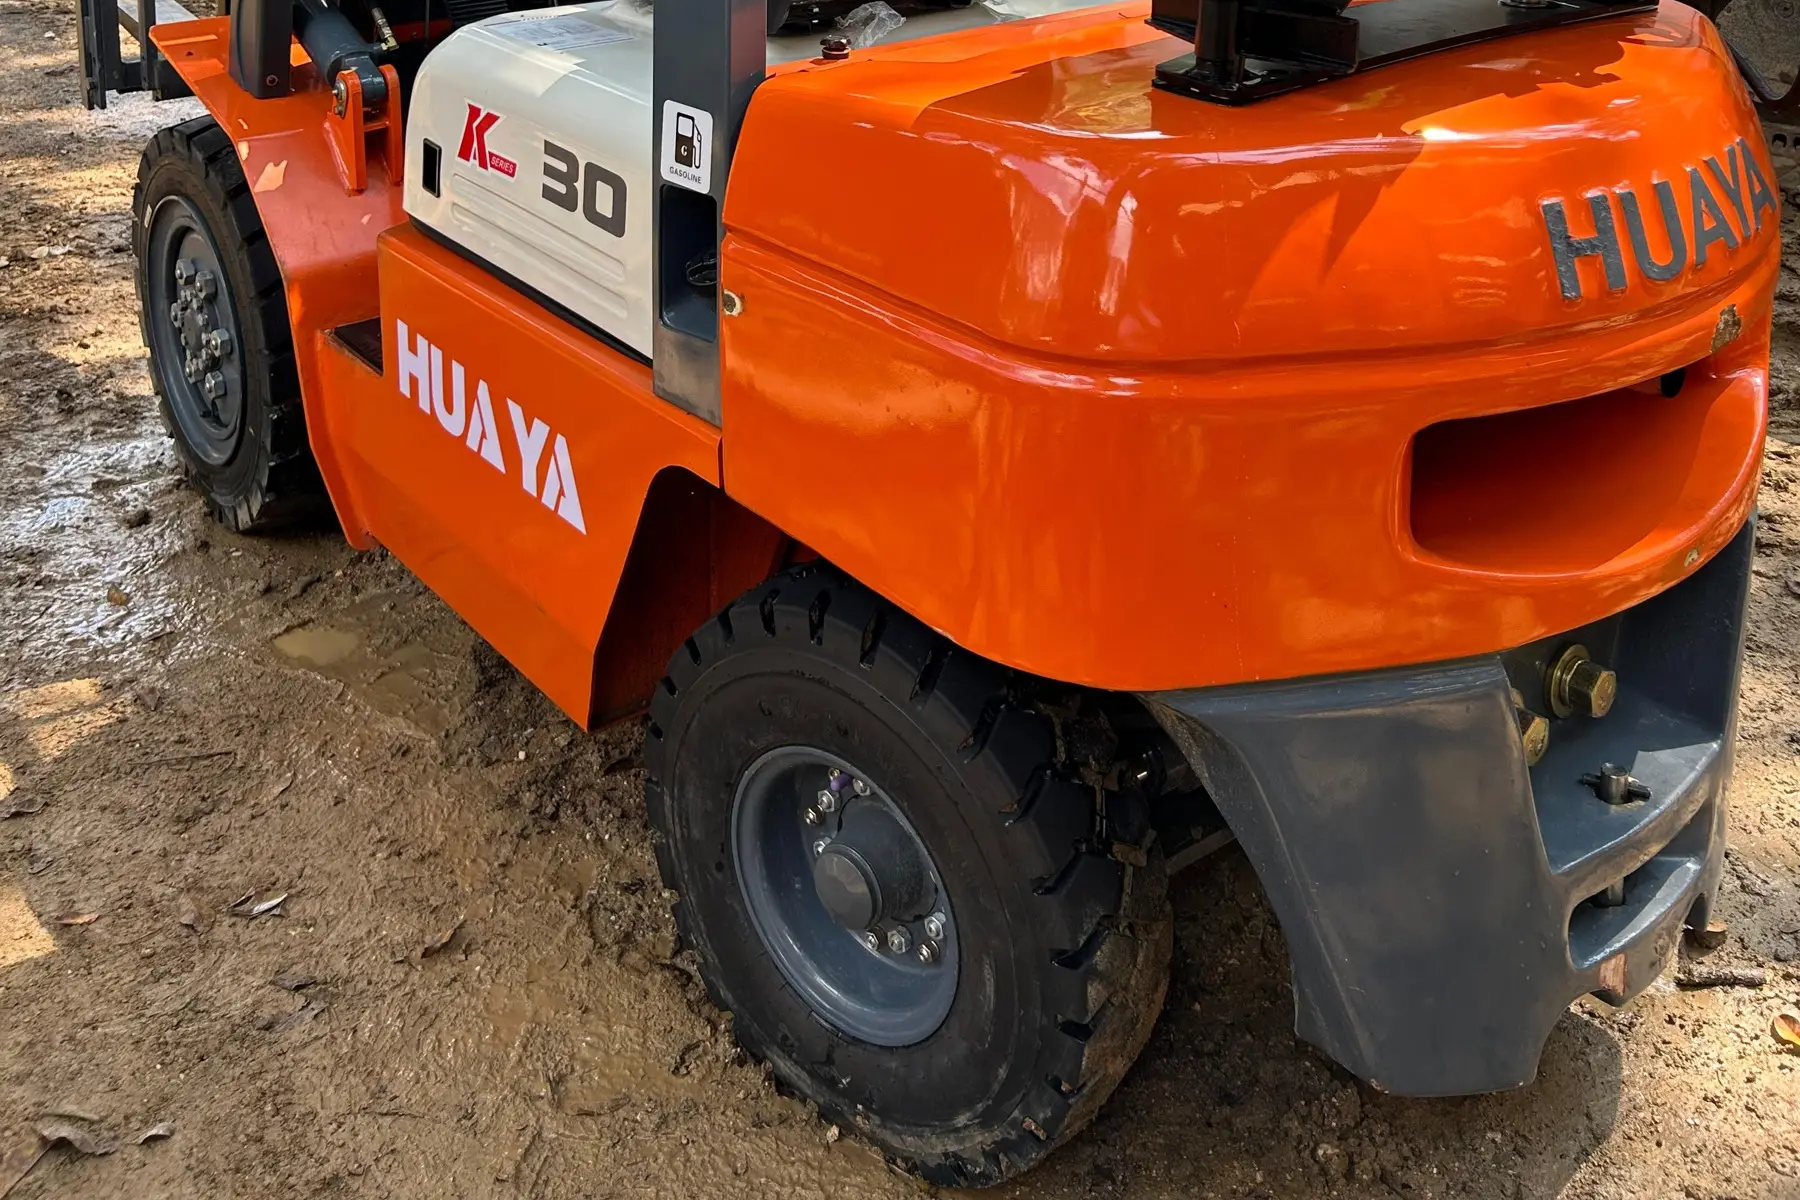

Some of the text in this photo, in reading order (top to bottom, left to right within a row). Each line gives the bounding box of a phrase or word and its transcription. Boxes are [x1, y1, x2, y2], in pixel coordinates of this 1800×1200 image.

[457, 102, 501, 171] K
[490, 156, 514, 174] SERIES
[669, 165, 702, 184] GASOLINE
[541, 139, 628, 238] 30
[1541, 137, 1777, 300] HUAYA
[397, 319, 587, 536] HUAYA
